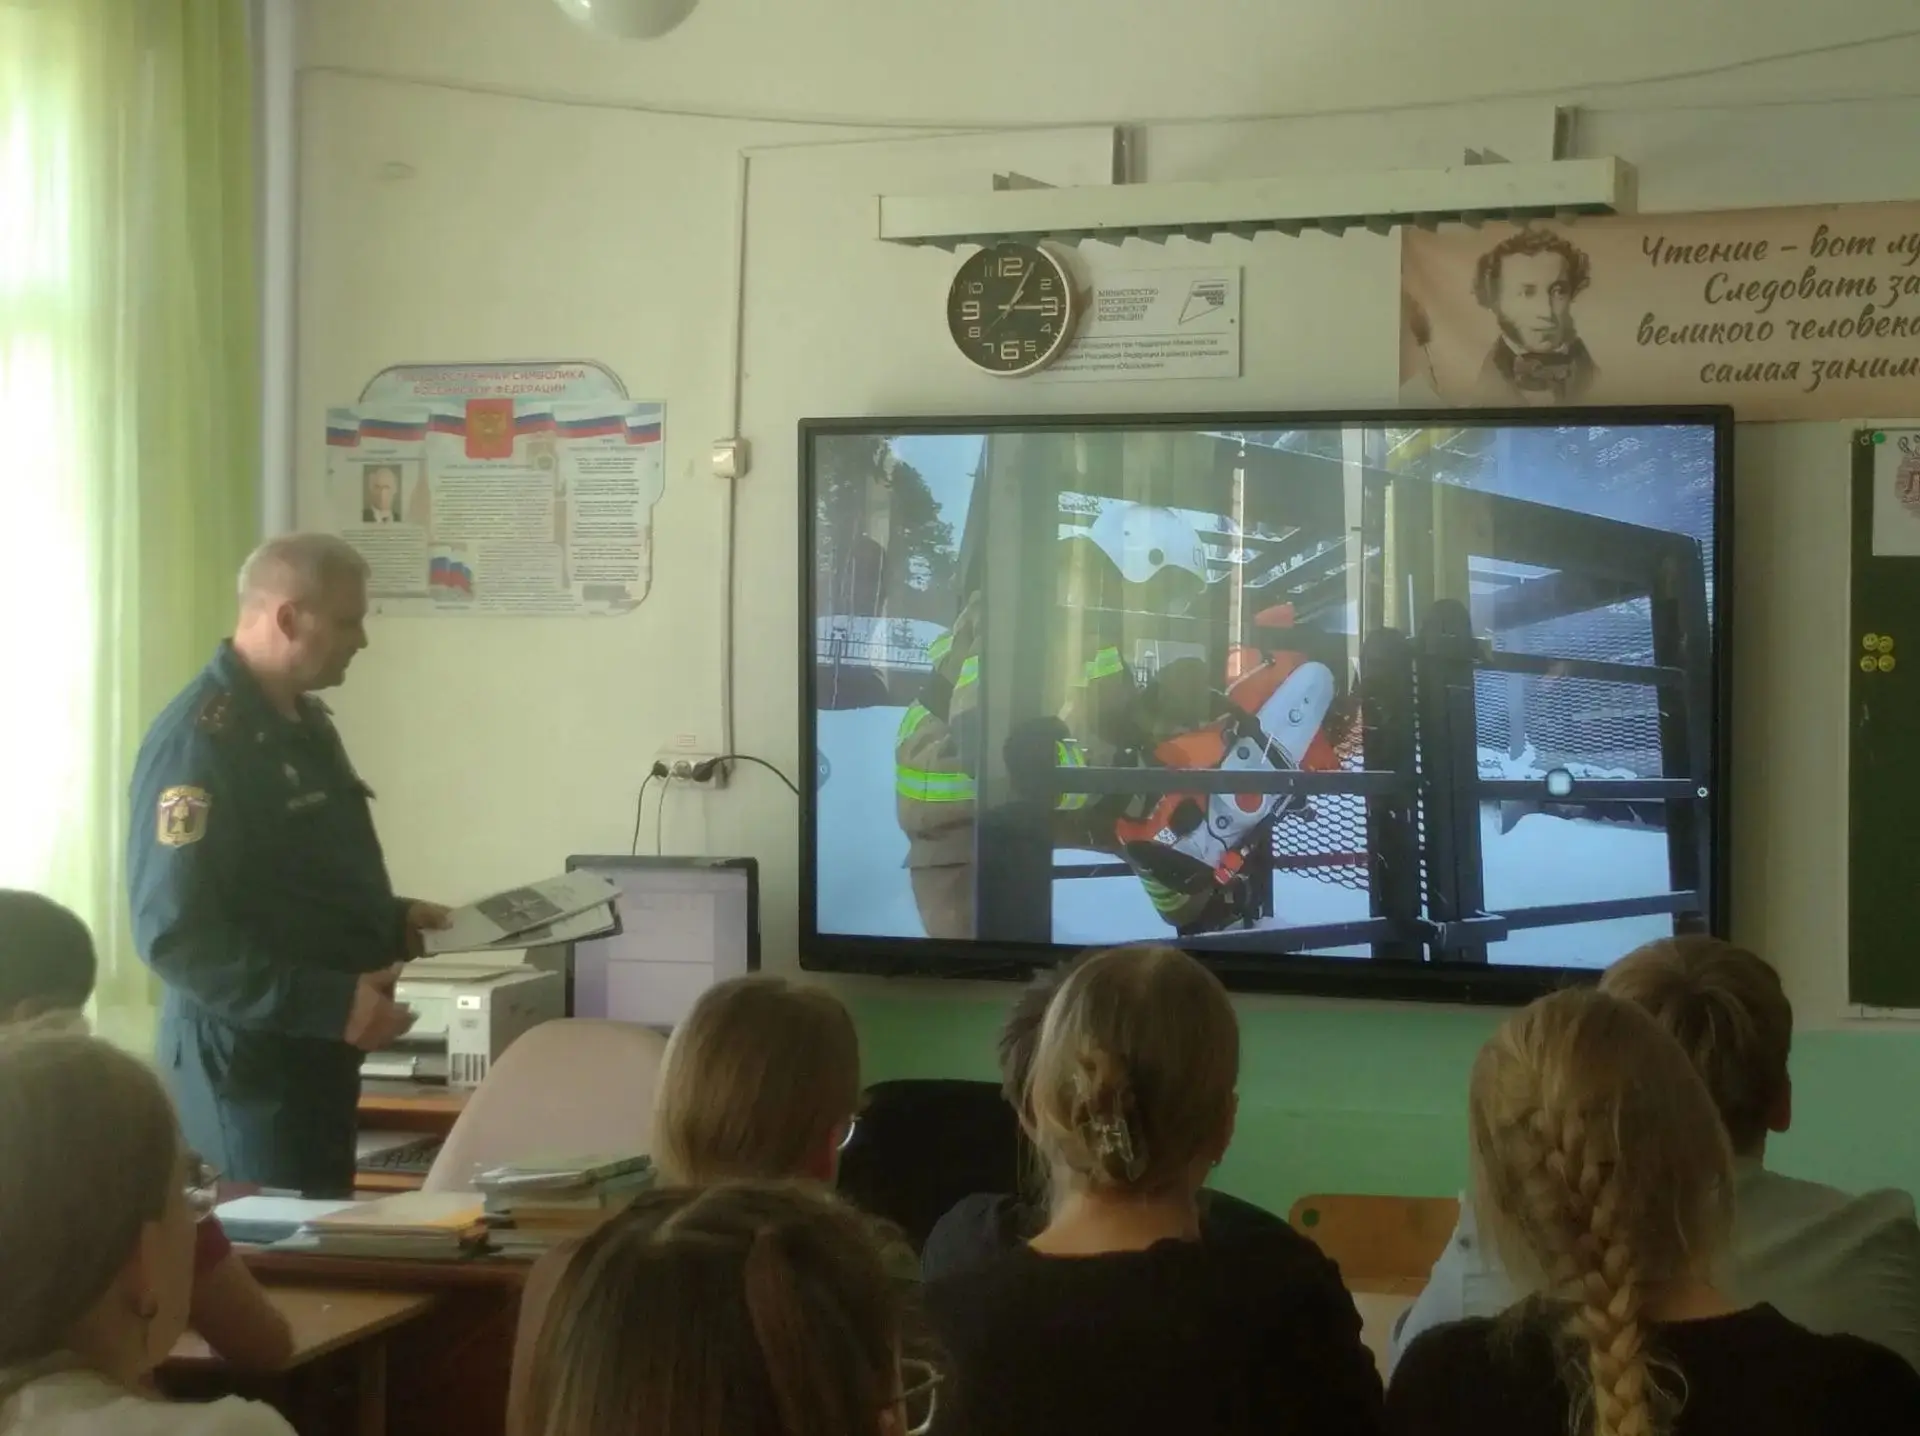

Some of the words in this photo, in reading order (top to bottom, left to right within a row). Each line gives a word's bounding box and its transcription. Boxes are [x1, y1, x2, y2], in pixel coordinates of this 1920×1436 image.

[1642, 235, 1769, 268] Чтение
[1810, 224, 1876, 258] вот
[998, 257, 1023, 277] 12
[968, 281, 984, 295] 10
[1040, 278, 1052, 291] 2
[1704, 265, 1877, 314] Следовать
[1878, 274, 1920, 309] за
[962, 300, 980, 321] 9
[1040, 296, 1059, 317] 3
[968, 326, 981, 339] 8
[1040, 322, 1052, 333] 4
[1637, 312, 1774, 346] великого
[982, 342, 995, 355] 7
[1000, 340, 1020, 360] 6
[1024, 340, 1036, 352] 5
[1700, 361, 1801, 383] самая
[1803, 357, 1920, 393] заним
